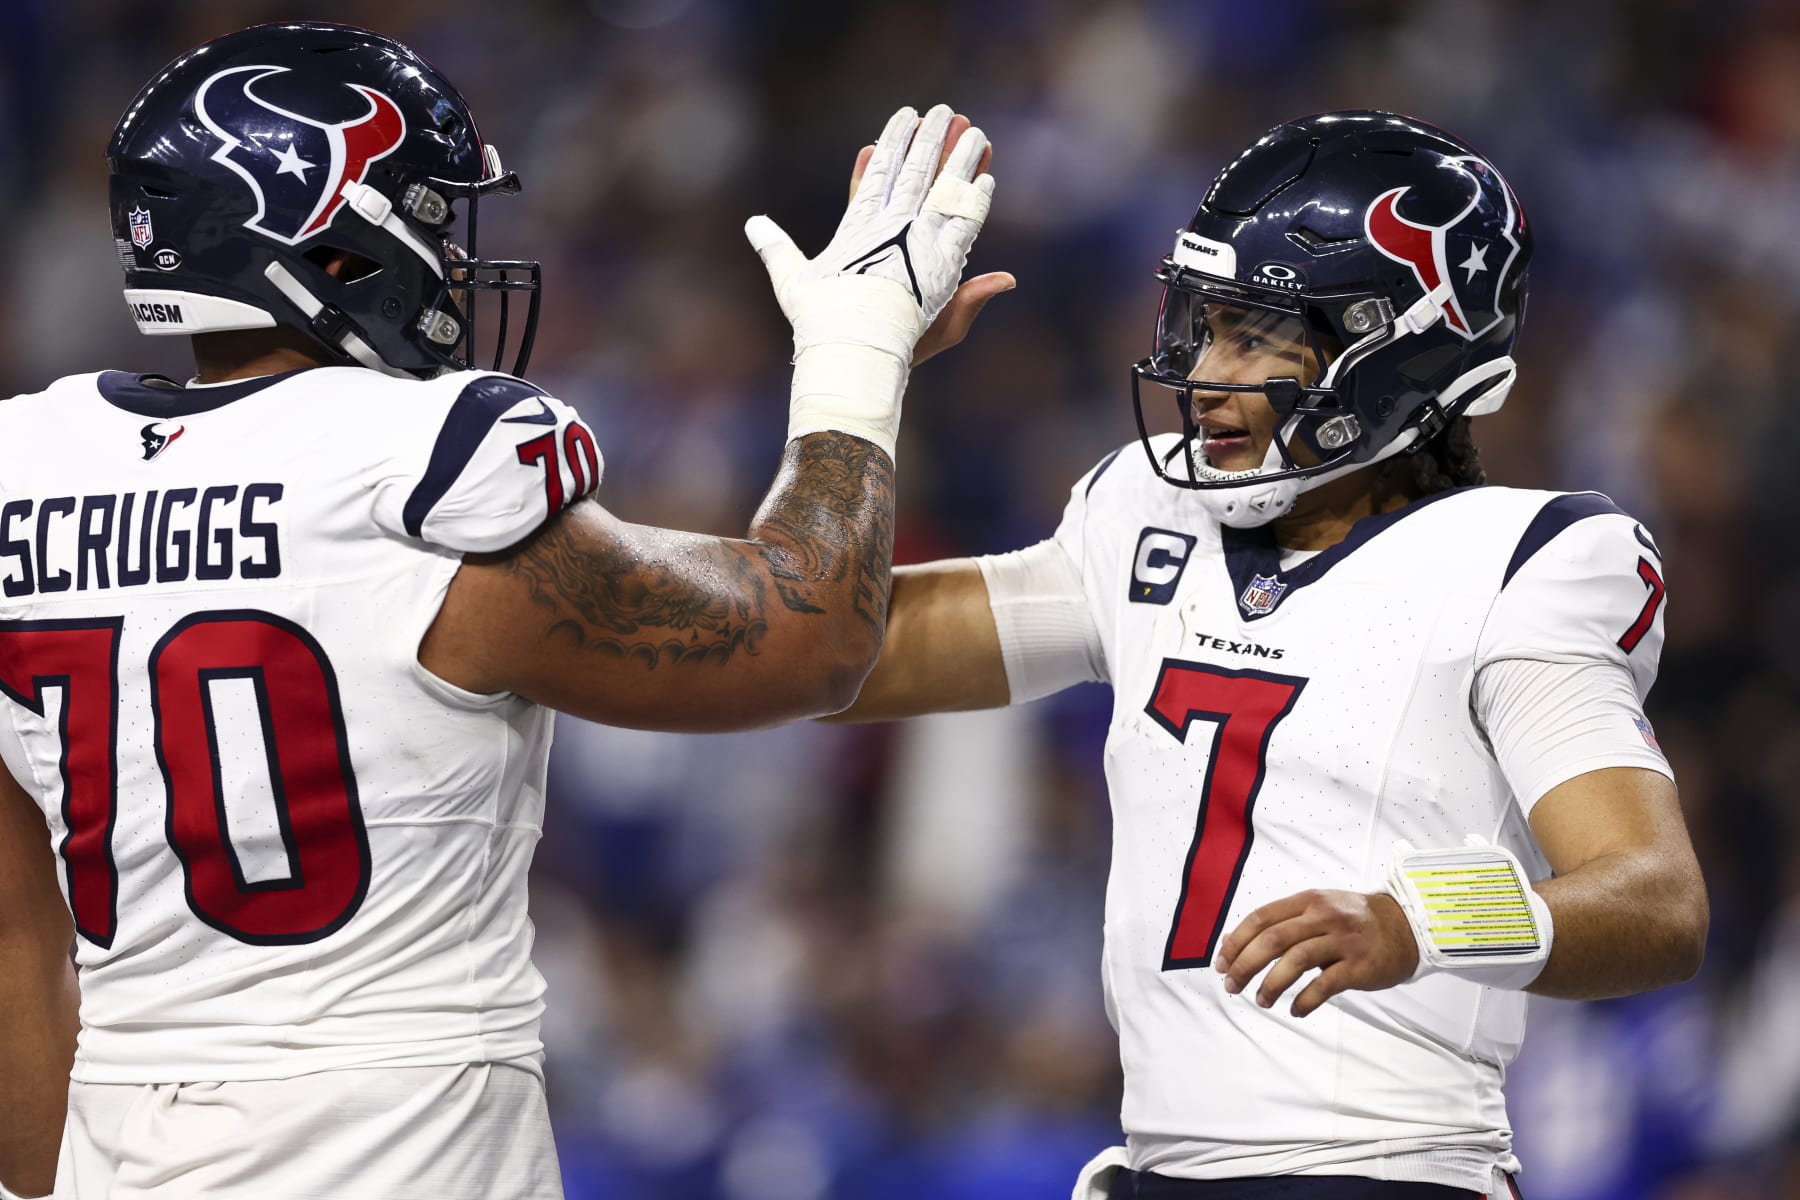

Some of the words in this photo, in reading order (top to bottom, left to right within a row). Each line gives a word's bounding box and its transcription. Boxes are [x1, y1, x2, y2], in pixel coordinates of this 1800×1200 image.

[133, 226, 150, 241] NFL
[1182, 238, 1220, 257] TEXANS
[1253, 275, 1304, 290] OAKLEY
[515, 420, 600, 519] 70
[0, 483, 284, 598] SCRUGGS
[1134, 533, 1187, 585] C
[1245, 589, 1273, 608] NFL
[1617, 555, 1666, 656] 7
[1195, 632, 1286, 660] TEXANS
[0, 608, 372, 950] 70
[1144, 657, 1310, 972] 7
